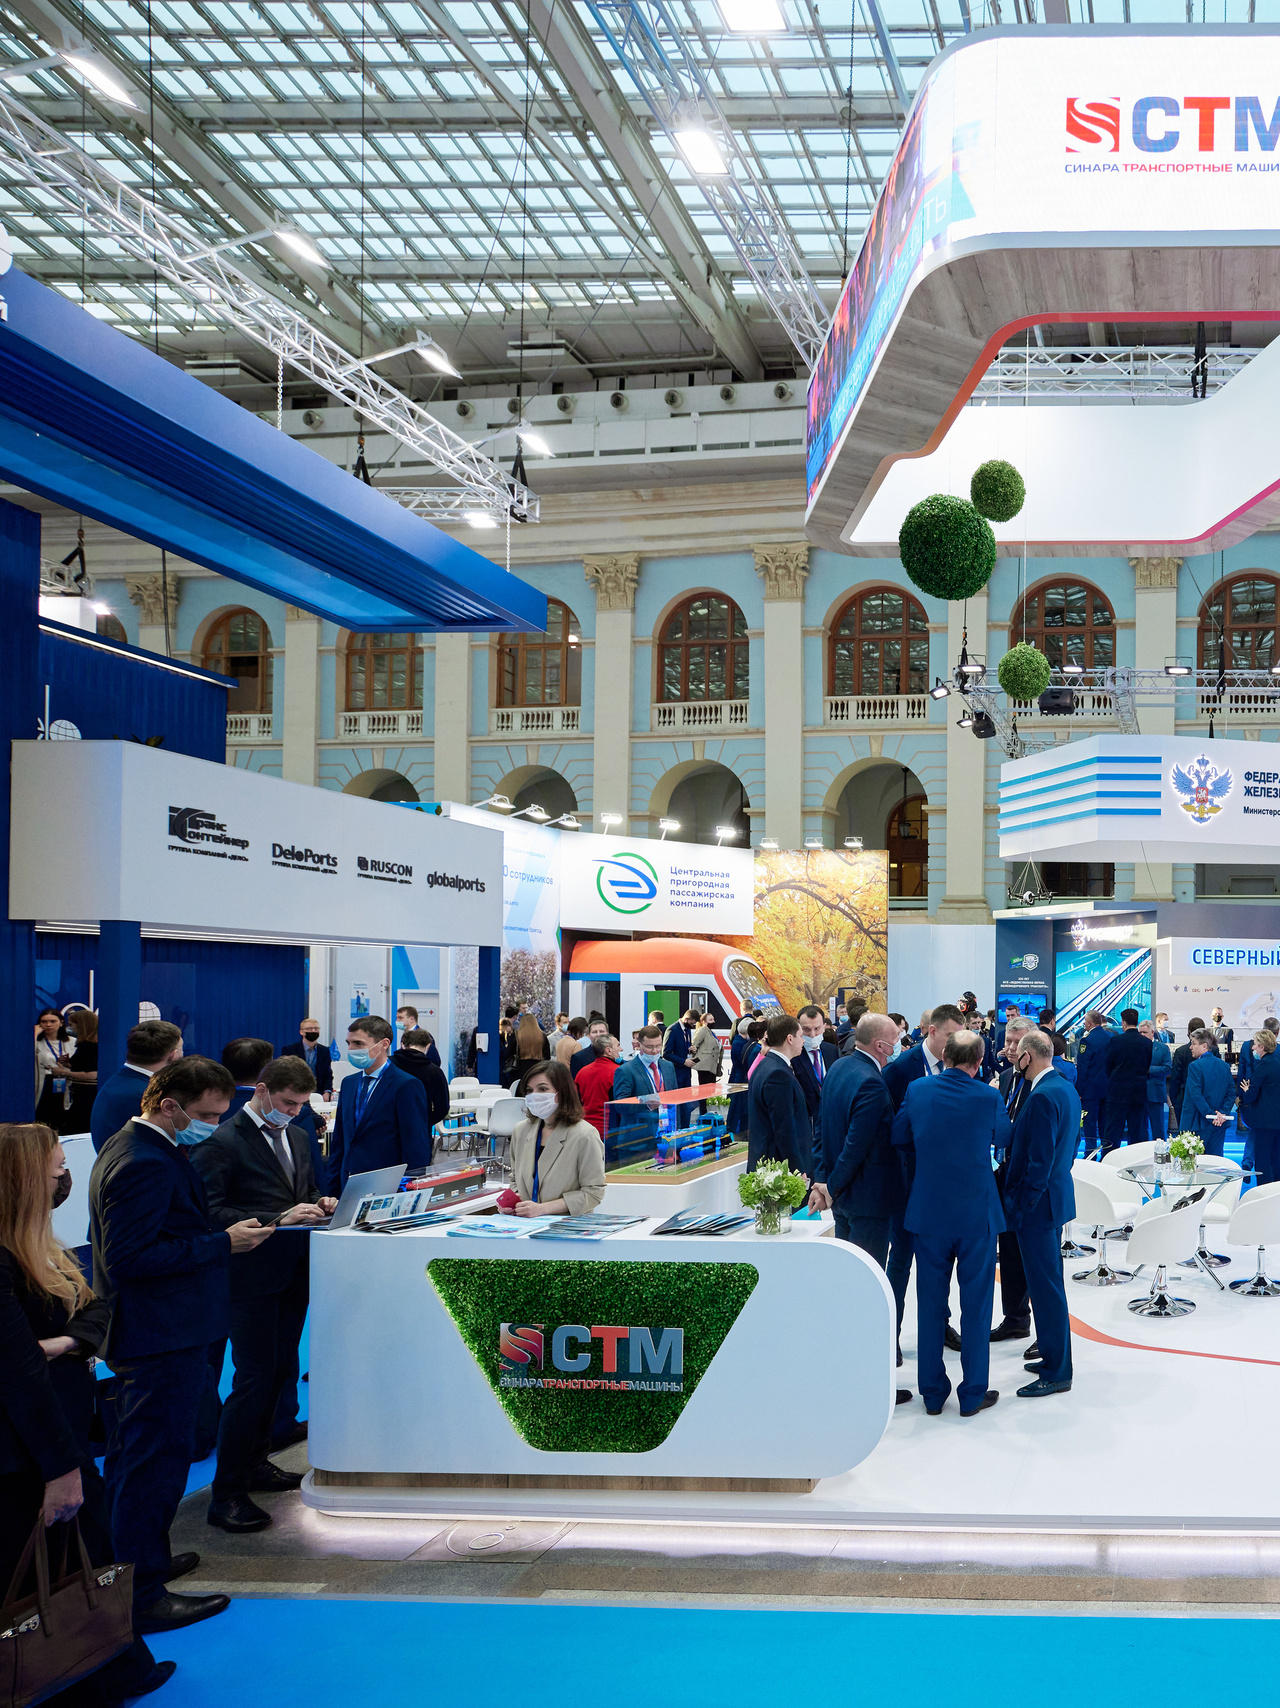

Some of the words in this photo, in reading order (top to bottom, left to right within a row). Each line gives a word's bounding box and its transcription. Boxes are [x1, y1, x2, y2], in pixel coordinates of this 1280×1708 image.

[1064, 163, 1120, 173] СИНАРА
[1122, 163, 1233, 173] ТРАНСПОРТНЫЕ
[272, 842, 338, 867] DeloPorts
[370, 859, 413, 877] RUSCON
[669, 866, 730, 878] Центральная
[426, 871, 486, 893] globalports
[510, 870, 554, 885] сотрудников
[669, 878, 730, 888] пригородная
[669, 889, 735, 899] пассажирская
[669, 899, 715, 908] компания
[552, 1324, 684, 1375] СТМ
